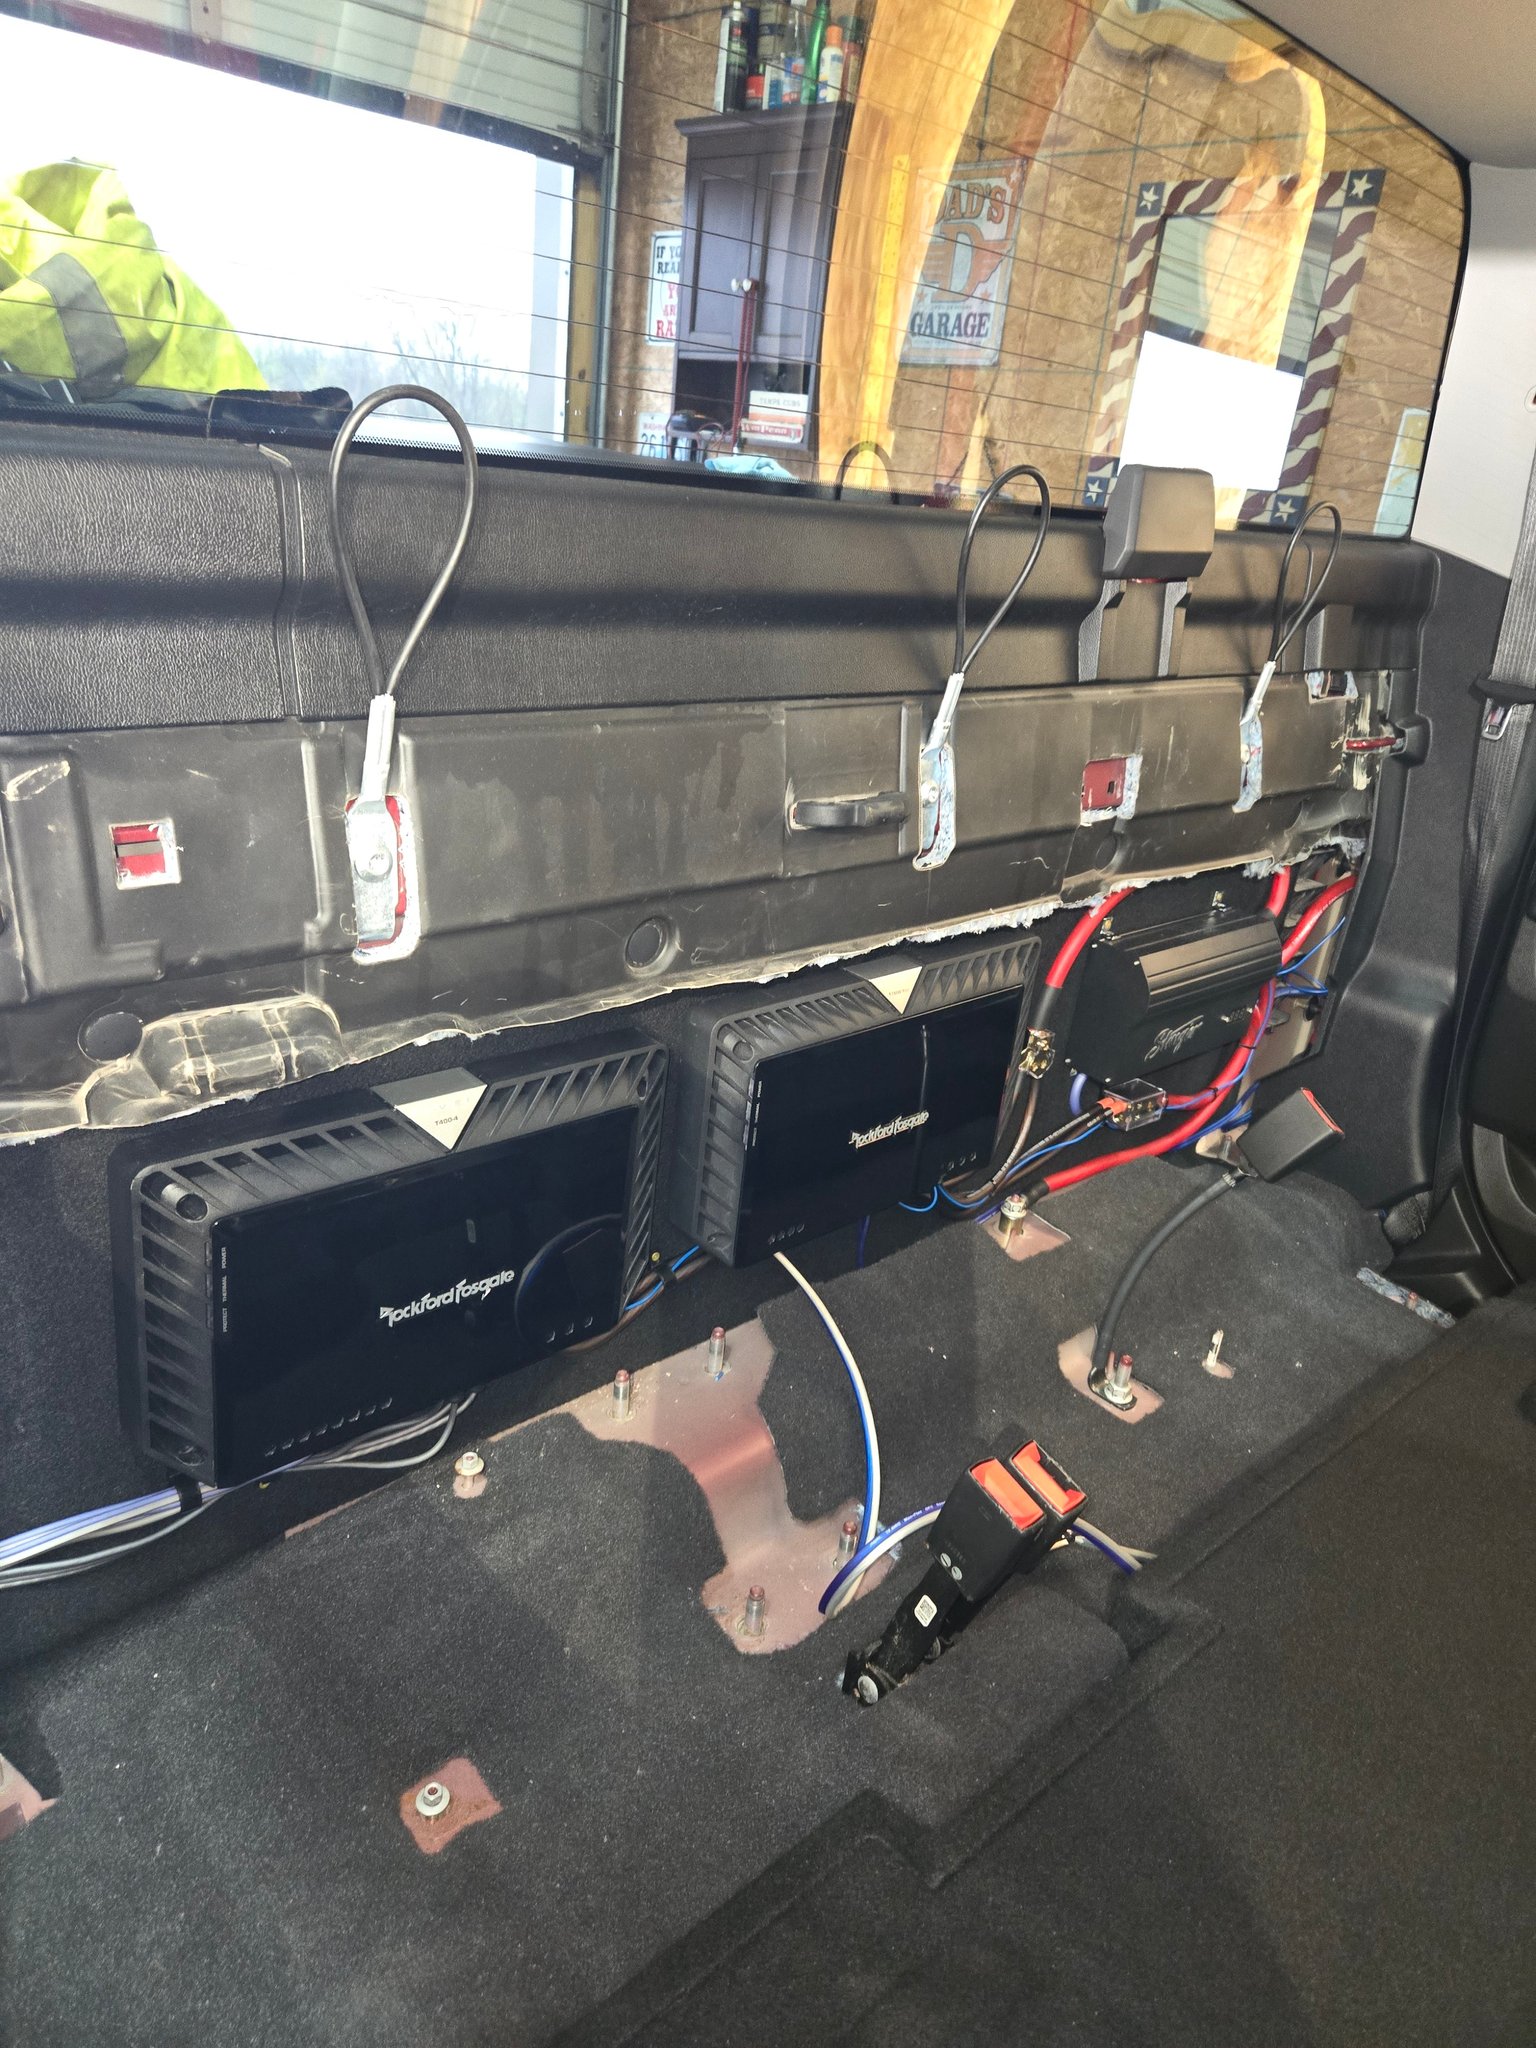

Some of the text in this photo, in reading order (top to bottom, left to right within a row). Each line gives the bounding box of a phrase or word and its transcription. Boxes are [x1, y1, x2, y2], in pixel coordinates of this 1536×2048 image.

[656, 246, 665, 258] IF
[910, 312, 991, 338] GARAGE
[848, 1122, 894, 1149] Rockford
[379, 1269, 515, 1328] Rockford Fosgate
